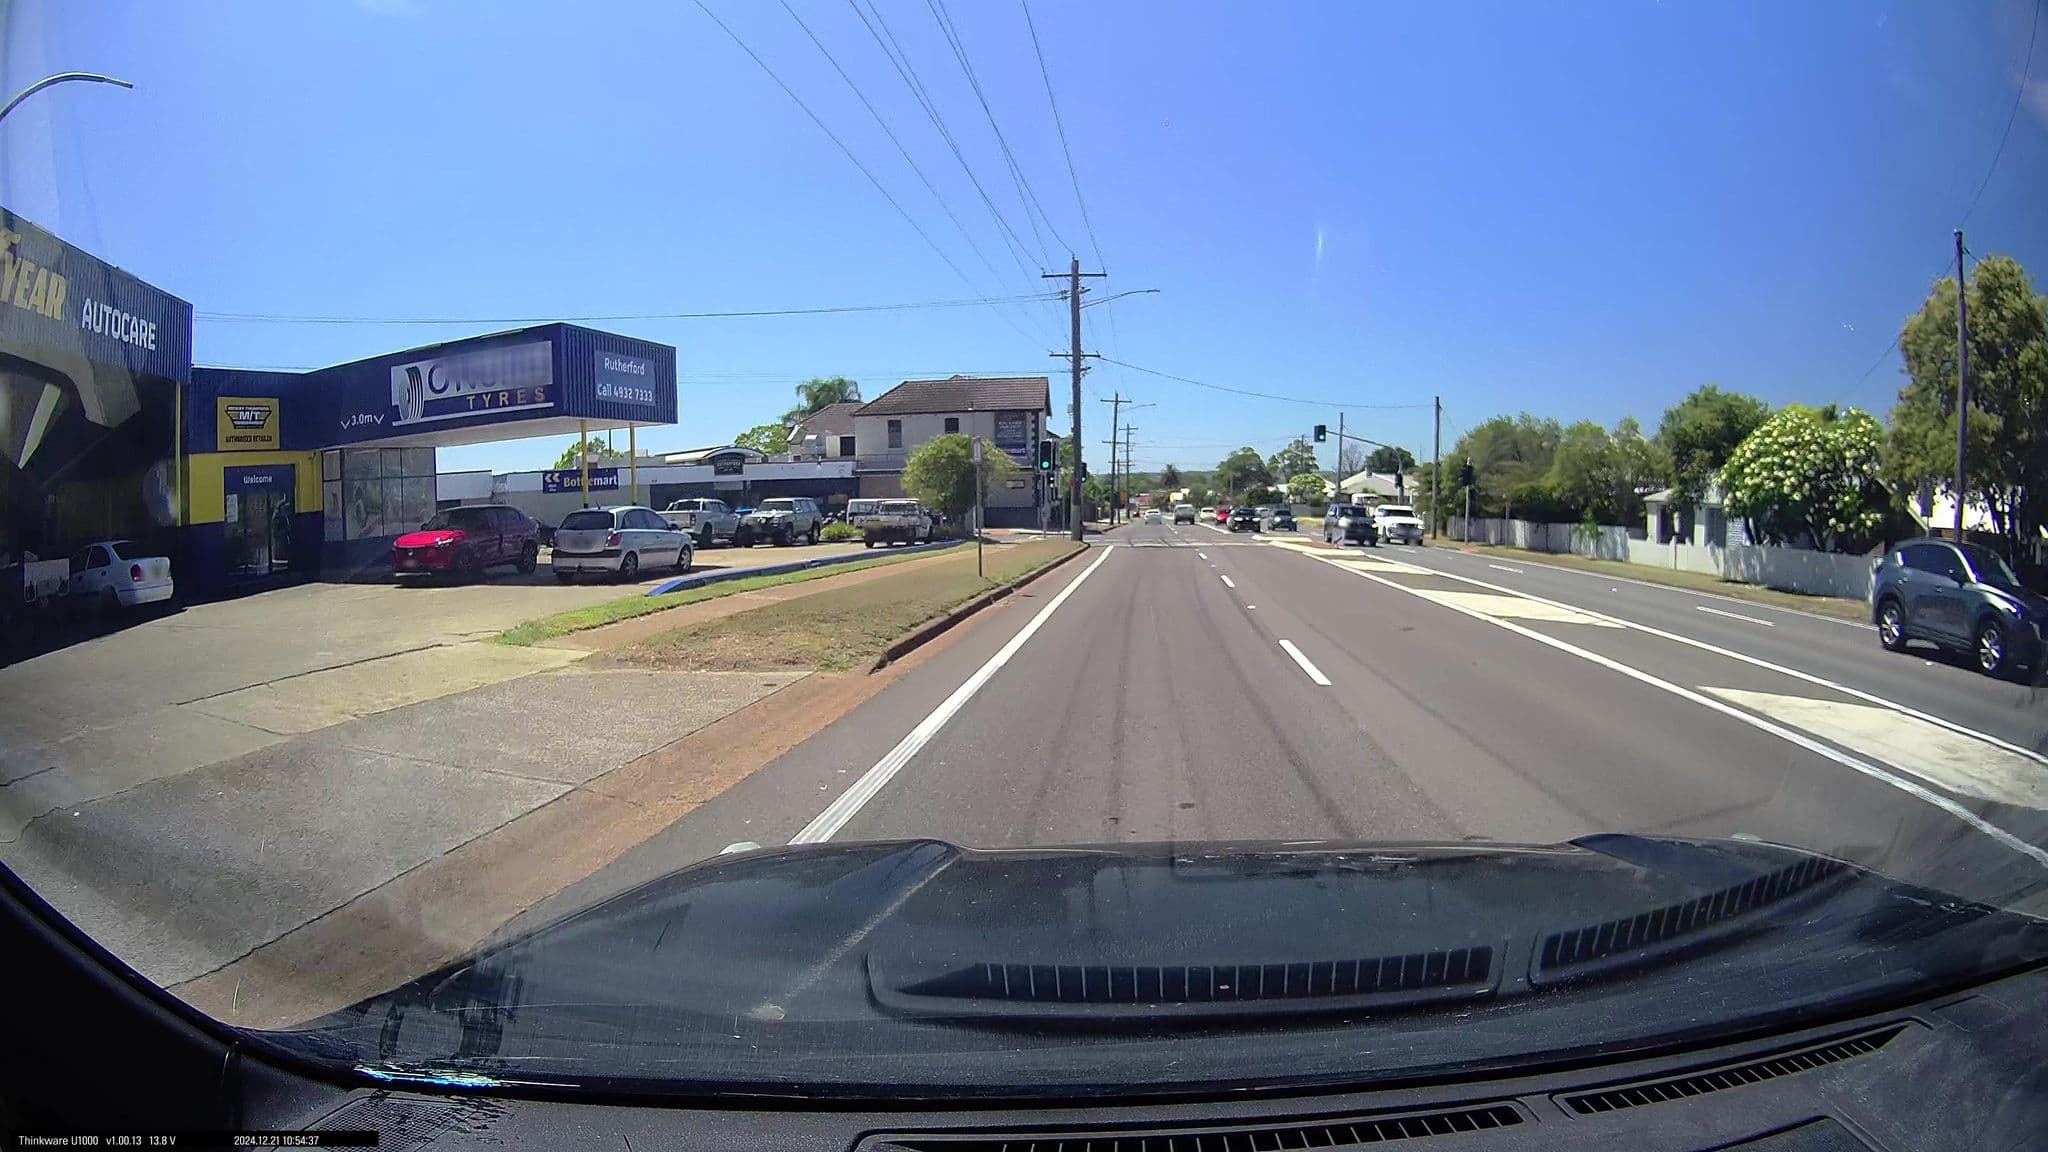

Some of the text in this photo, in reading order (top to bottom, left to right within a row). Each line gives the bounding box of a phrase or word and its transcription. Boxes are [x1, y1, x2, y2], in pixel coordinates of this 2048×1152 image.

[0, 251, 66, 321] YEAR
[81, 298, 156, 351] AUTOCARE
[604, 357, 646, 376] Rutherford
[465, 386, 546, 411] TYRES
[597, 383, 653, 402] Call 4932 7333
[239, 410, 261, 421] M/T
[350, 413, 373, 426] 3.0m
[243, 474, 273, 484] Welcome
